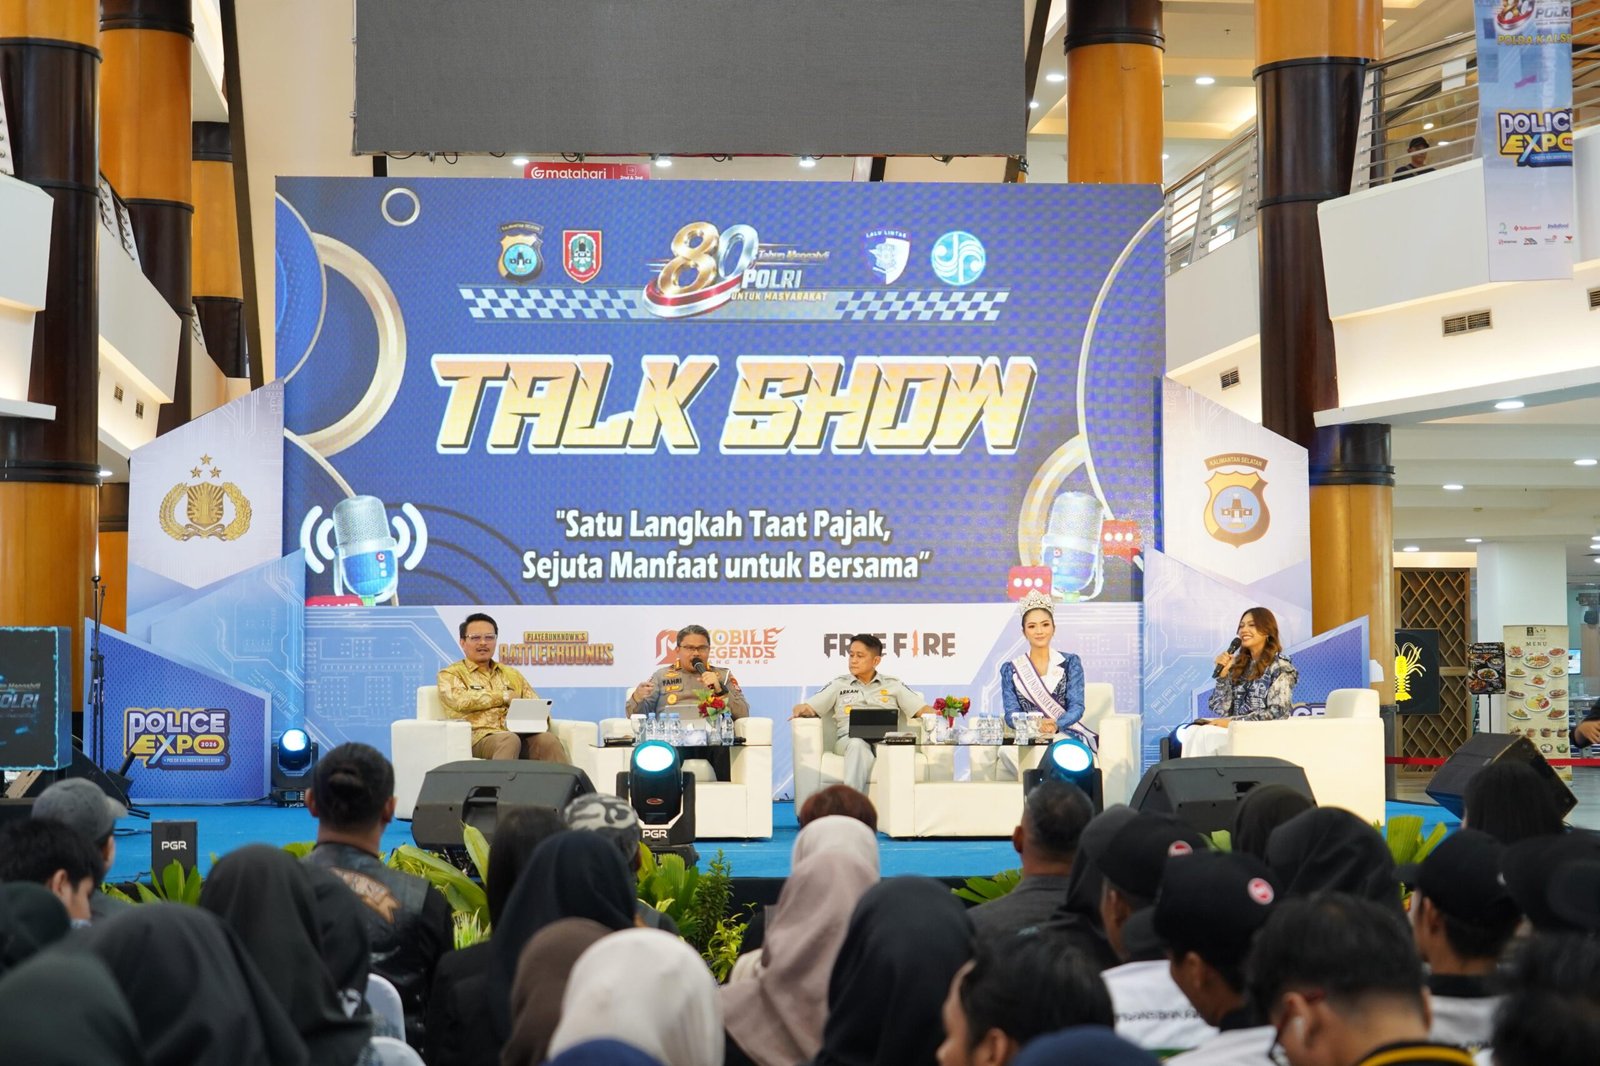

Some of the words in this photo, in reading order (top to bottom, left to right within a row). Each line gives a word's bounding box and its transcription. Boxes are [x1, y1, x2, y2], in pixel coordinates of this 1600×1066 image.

[1536, 6, 1570, 18] POLR
[1498, 34, 1533, 45] POLDA
[1500, 112, 1573, 148] POLIC
[546, 168, 606, 179] matahari
[884, 230, 907, 238] LINTAS
[657, 221, 760, 296] 80
[741, 269, 802, 289] POLRI
[731, 291, 761, 301] UNTUK
[763, 291, 827, 301] MASYARAKAT
[431, 354, 719, 455] TALK
[719, 355, 1037, 455] SHOW
[556, 509, 623, 538] "Satu
[629, 510, 742, 546] Langkah
[749, 510, 807, 537] Taat
[813, 509, 891, 546] Pajak,
[522, 551, 603, 588] Sejuta
[609, 550, 719, 579] Manfaat
[725, 551, 802, 579] untuk
[707, 627, 785, 645] OBILE
[823, 632, 887, 658] FRE
[893, 629, 956, 658] FIRE
[499, 643, 614, 666] BATTLEGROUNDS
[708, 645, 777, 659] EGENDS
[662, 678, 682, 686] FAHRI
[0, 693, 40, 708] OLRI
[129, 712, 225, 748] POLICE
[130, 734, 225, 764] EXPO
[642, 829, 668, 838] PGR
[161, 841, 188, 850] PGR
